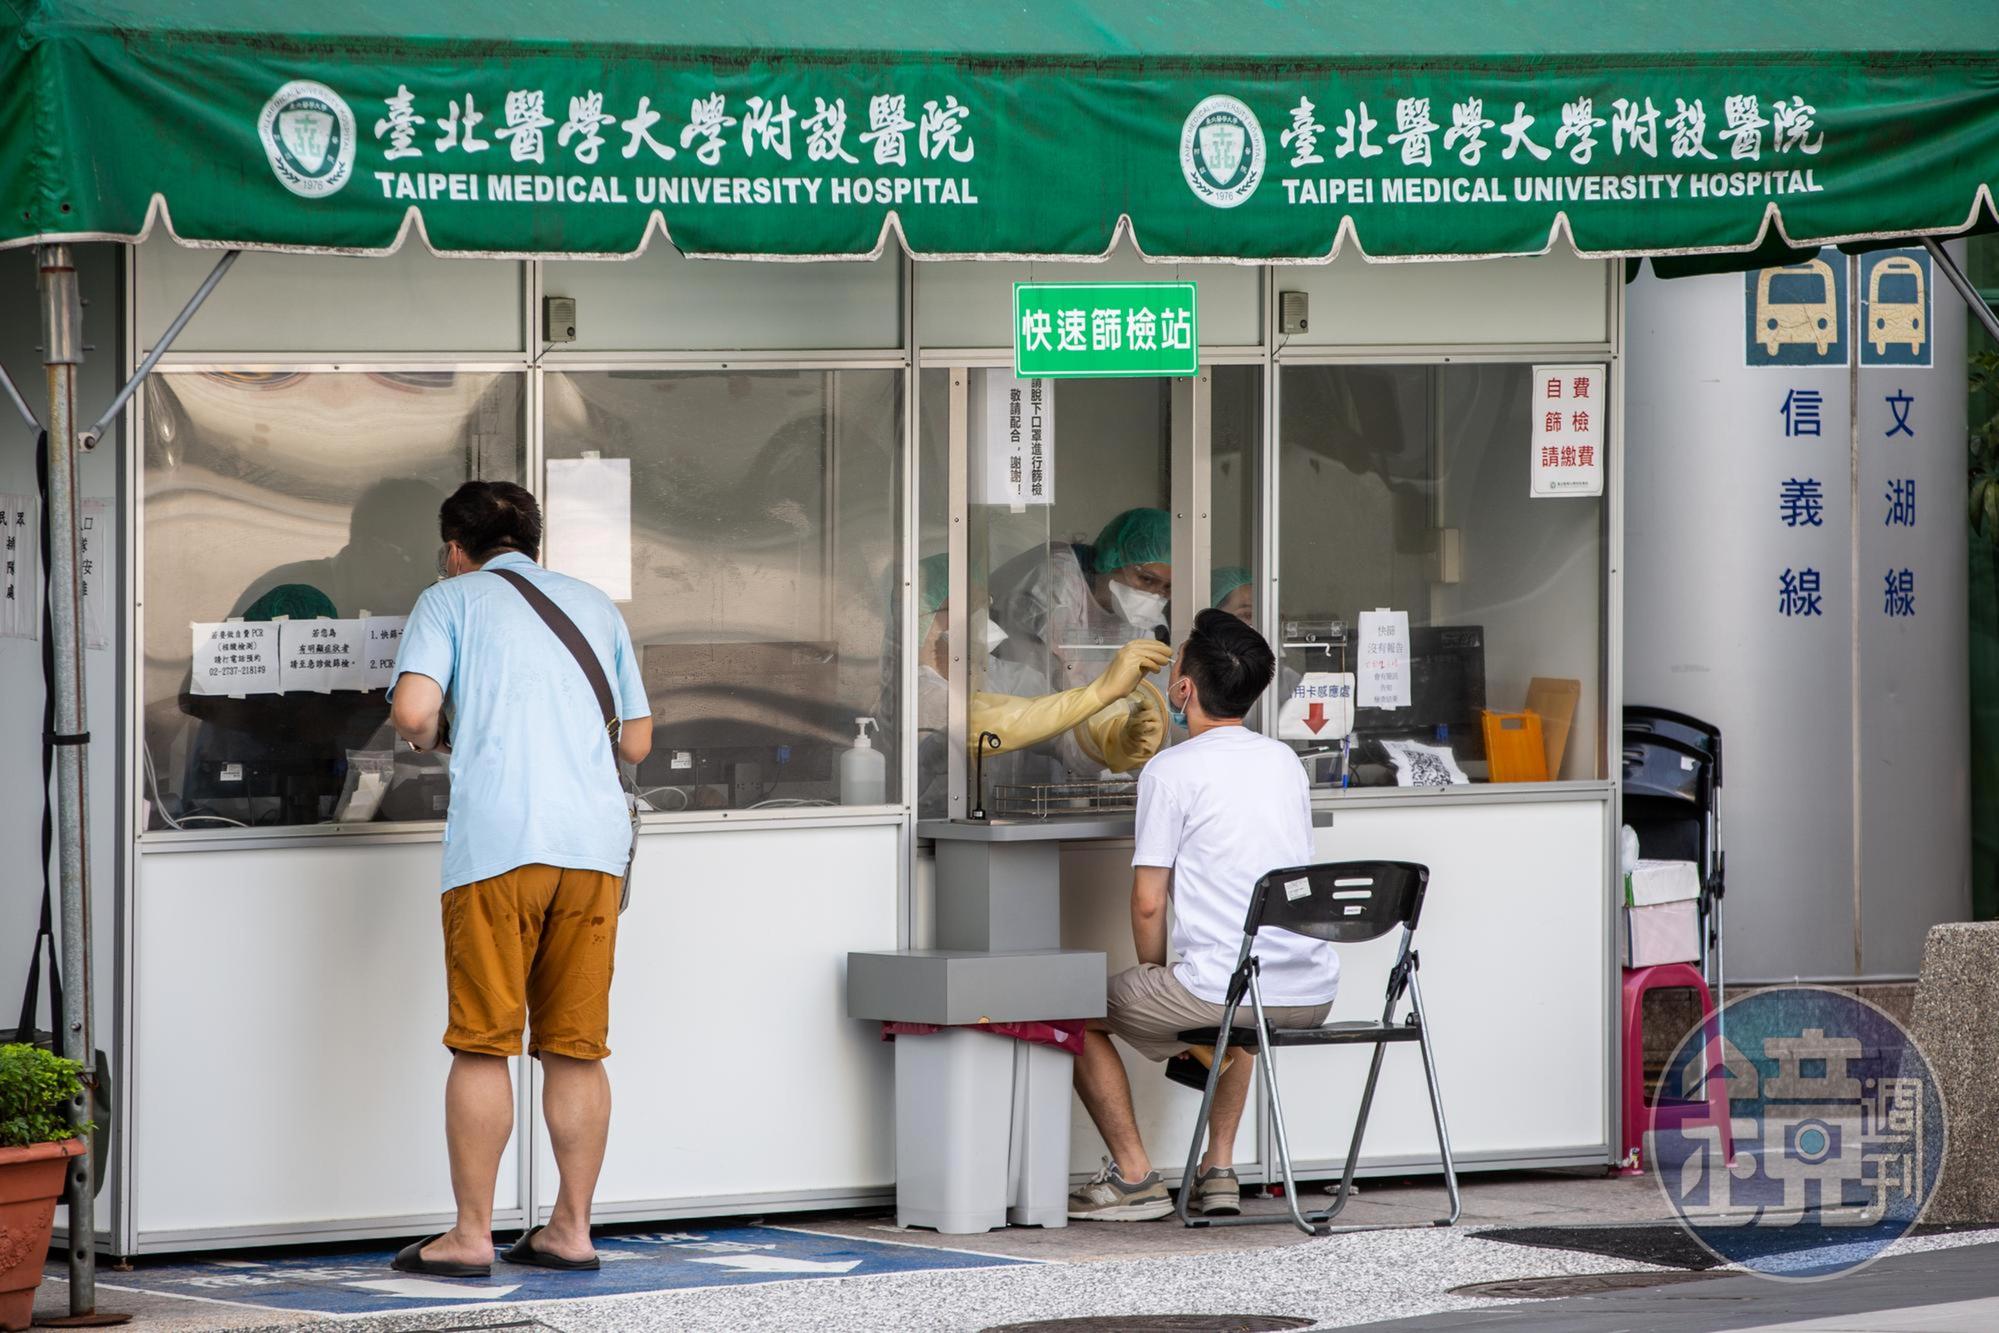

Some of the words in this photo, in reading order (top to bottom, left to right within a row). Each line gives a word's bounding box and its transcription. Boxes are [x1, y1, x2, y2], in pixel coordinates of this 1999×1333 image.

[375, 85, 974, 166] 臺北醫學大學附設醫院
[1280, 95, 1823, 168] 臺北醫學大學附設醫院
[303, 180, 324, 190] 1976
[375, 172, 478, 200] TAIPEI
[488, 175, 627, 202] MEDICAL
[636, 177, 822, 204] UNIVERSITY
[831, 178, 977, 203] HOSPITAL
[1215, 191, 1234, 201] 1976
[1282, 179, 1373, 203] TAIPEI
[1382, 178, 1507, 202] MEDICAL
[1514, 175, 1682, 201] UNIVERSITY
[1691, 170, 1823, 197] HOSPITAL
[1021, 307, 1192, 351] 快速篩檢站
[1547, 377, 1590, 399] 自費
[1545, 411, 1590, 433] 篩檢
[1541, 445, 1594, 468] 請繳費
[1779, 389, 1824, 617] 信義線
[1884, 389, 1916, 617] 文湖線
